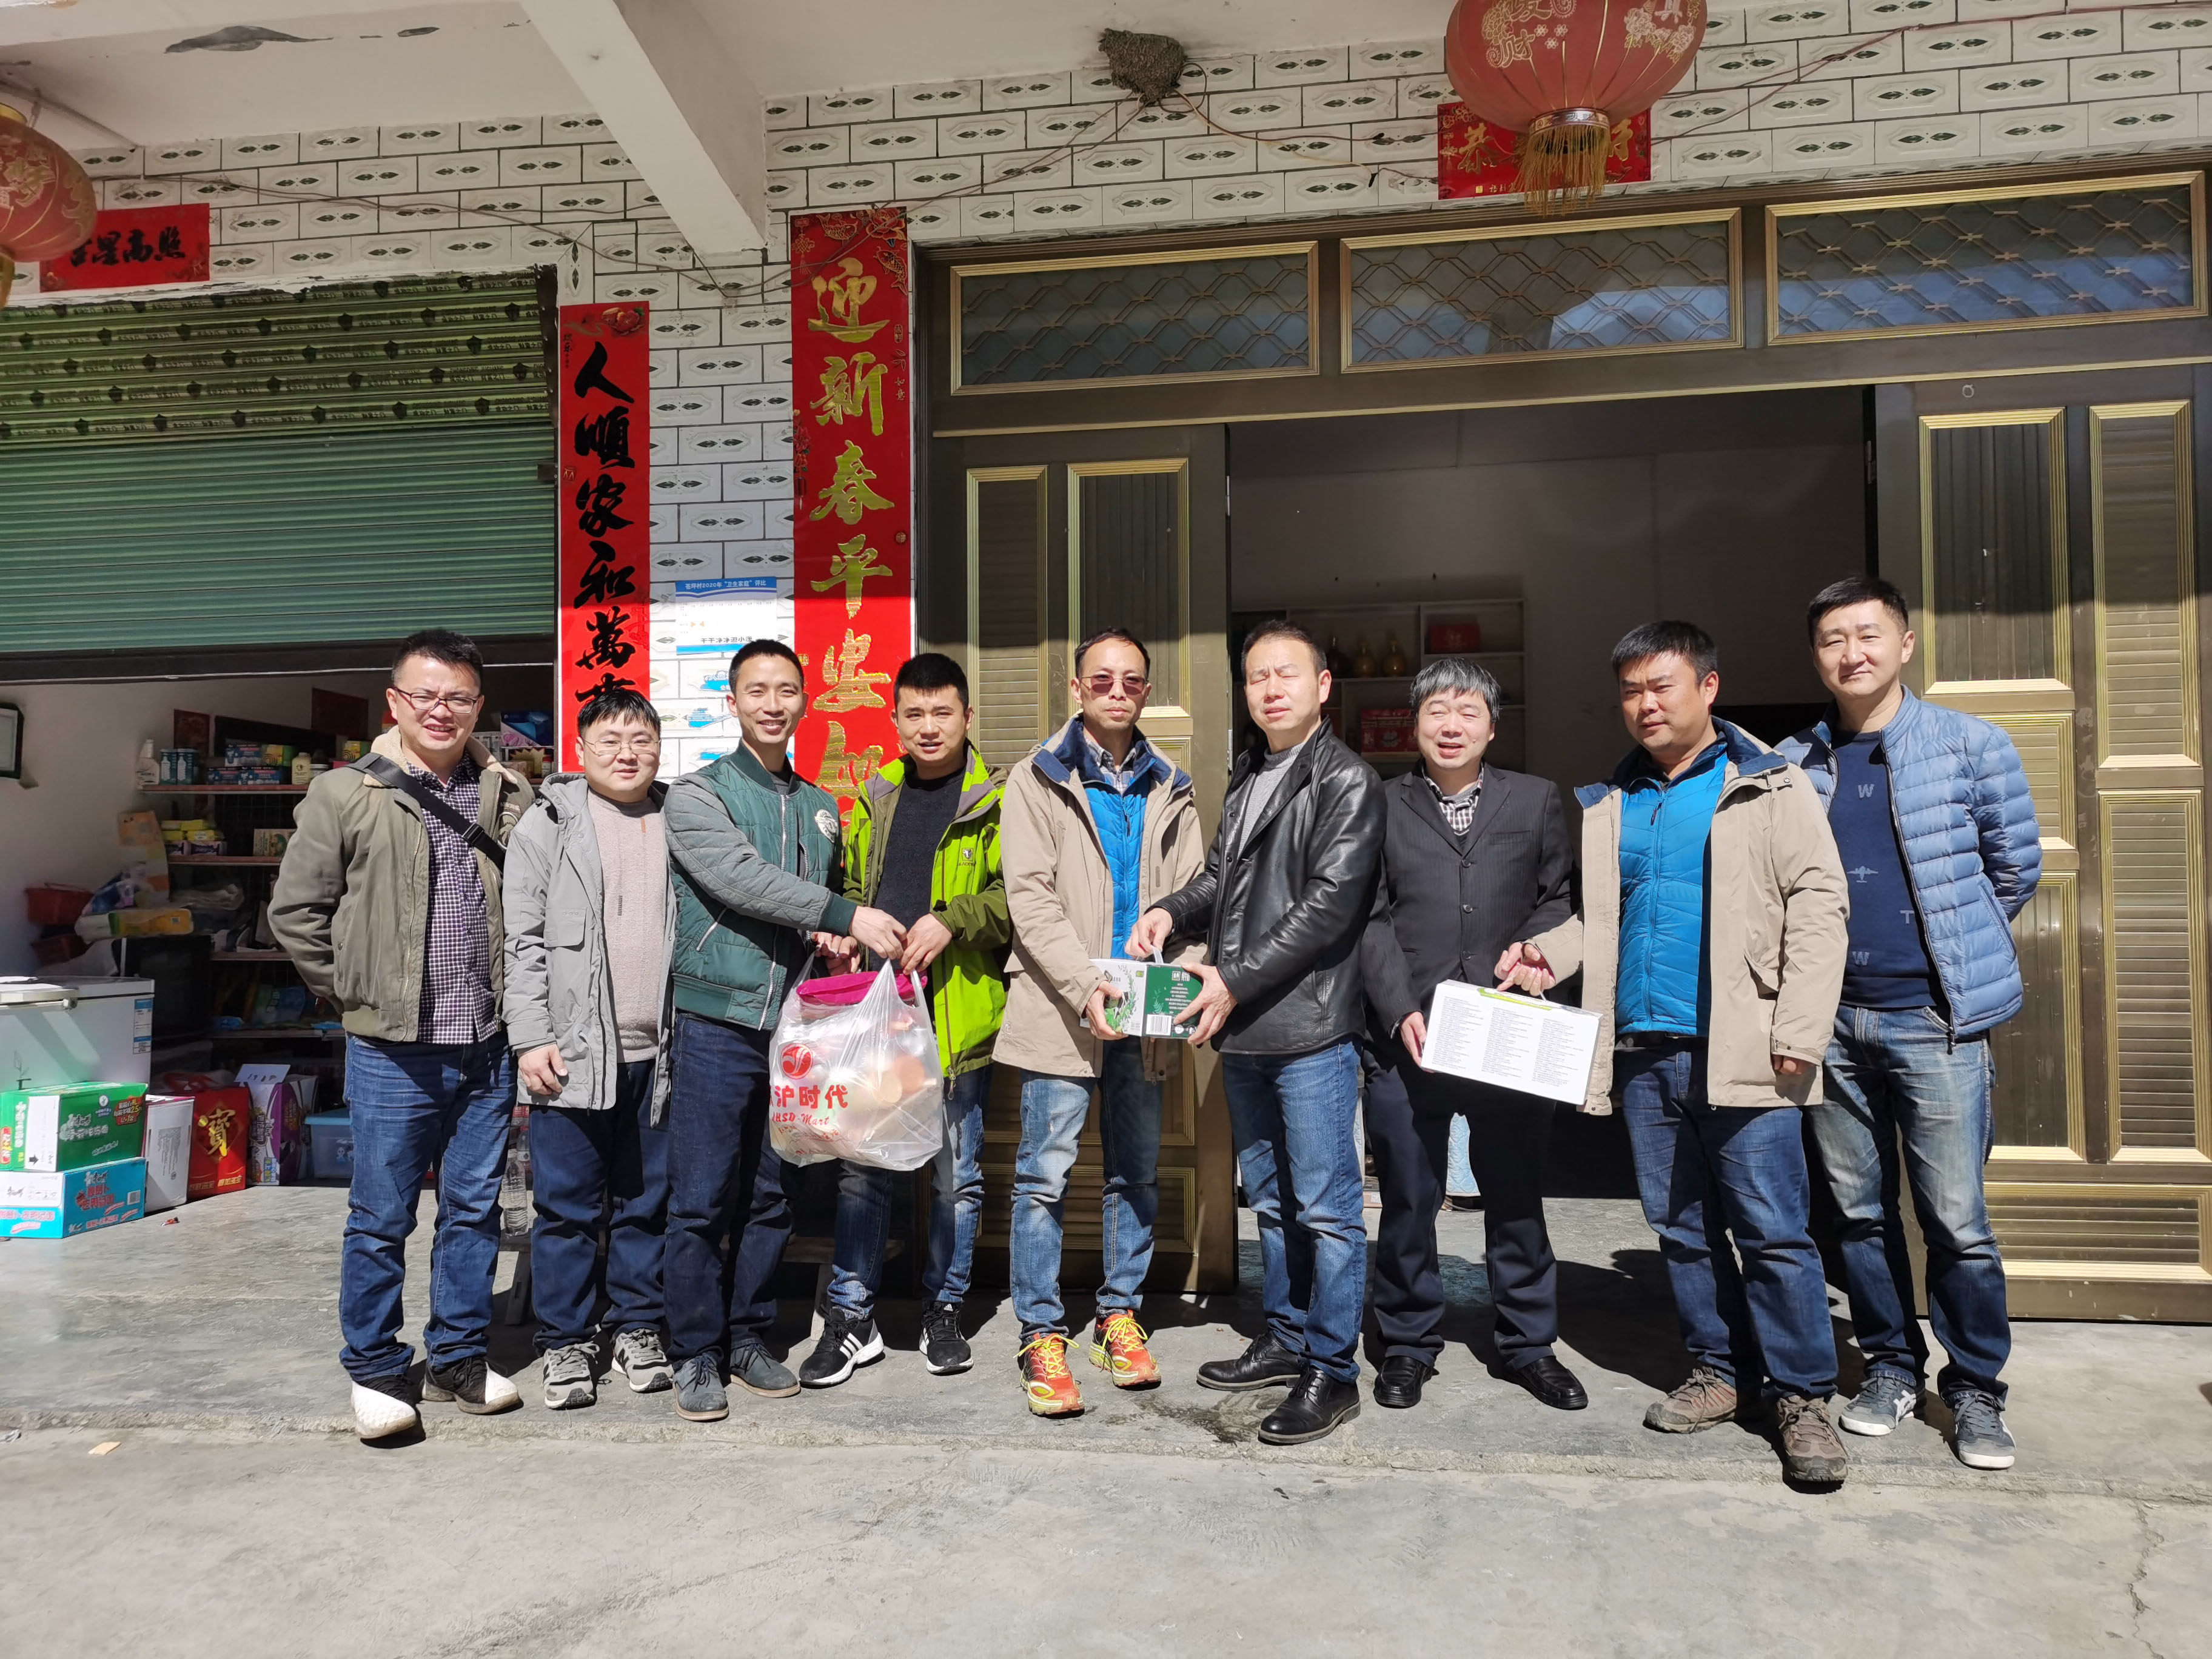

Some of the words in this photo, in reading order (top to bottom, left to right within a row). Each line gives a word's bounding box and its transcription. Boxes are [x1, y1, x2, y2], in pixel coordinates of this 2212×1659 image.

[808, 257, 895, 846] 迎新春平安如
[1858, 784, 1875, 799] W
[1900, 910, 1915, 925] T
[1851, 951, 1870, 966] W
[770, 1084, 848, 1109] 沪时代
